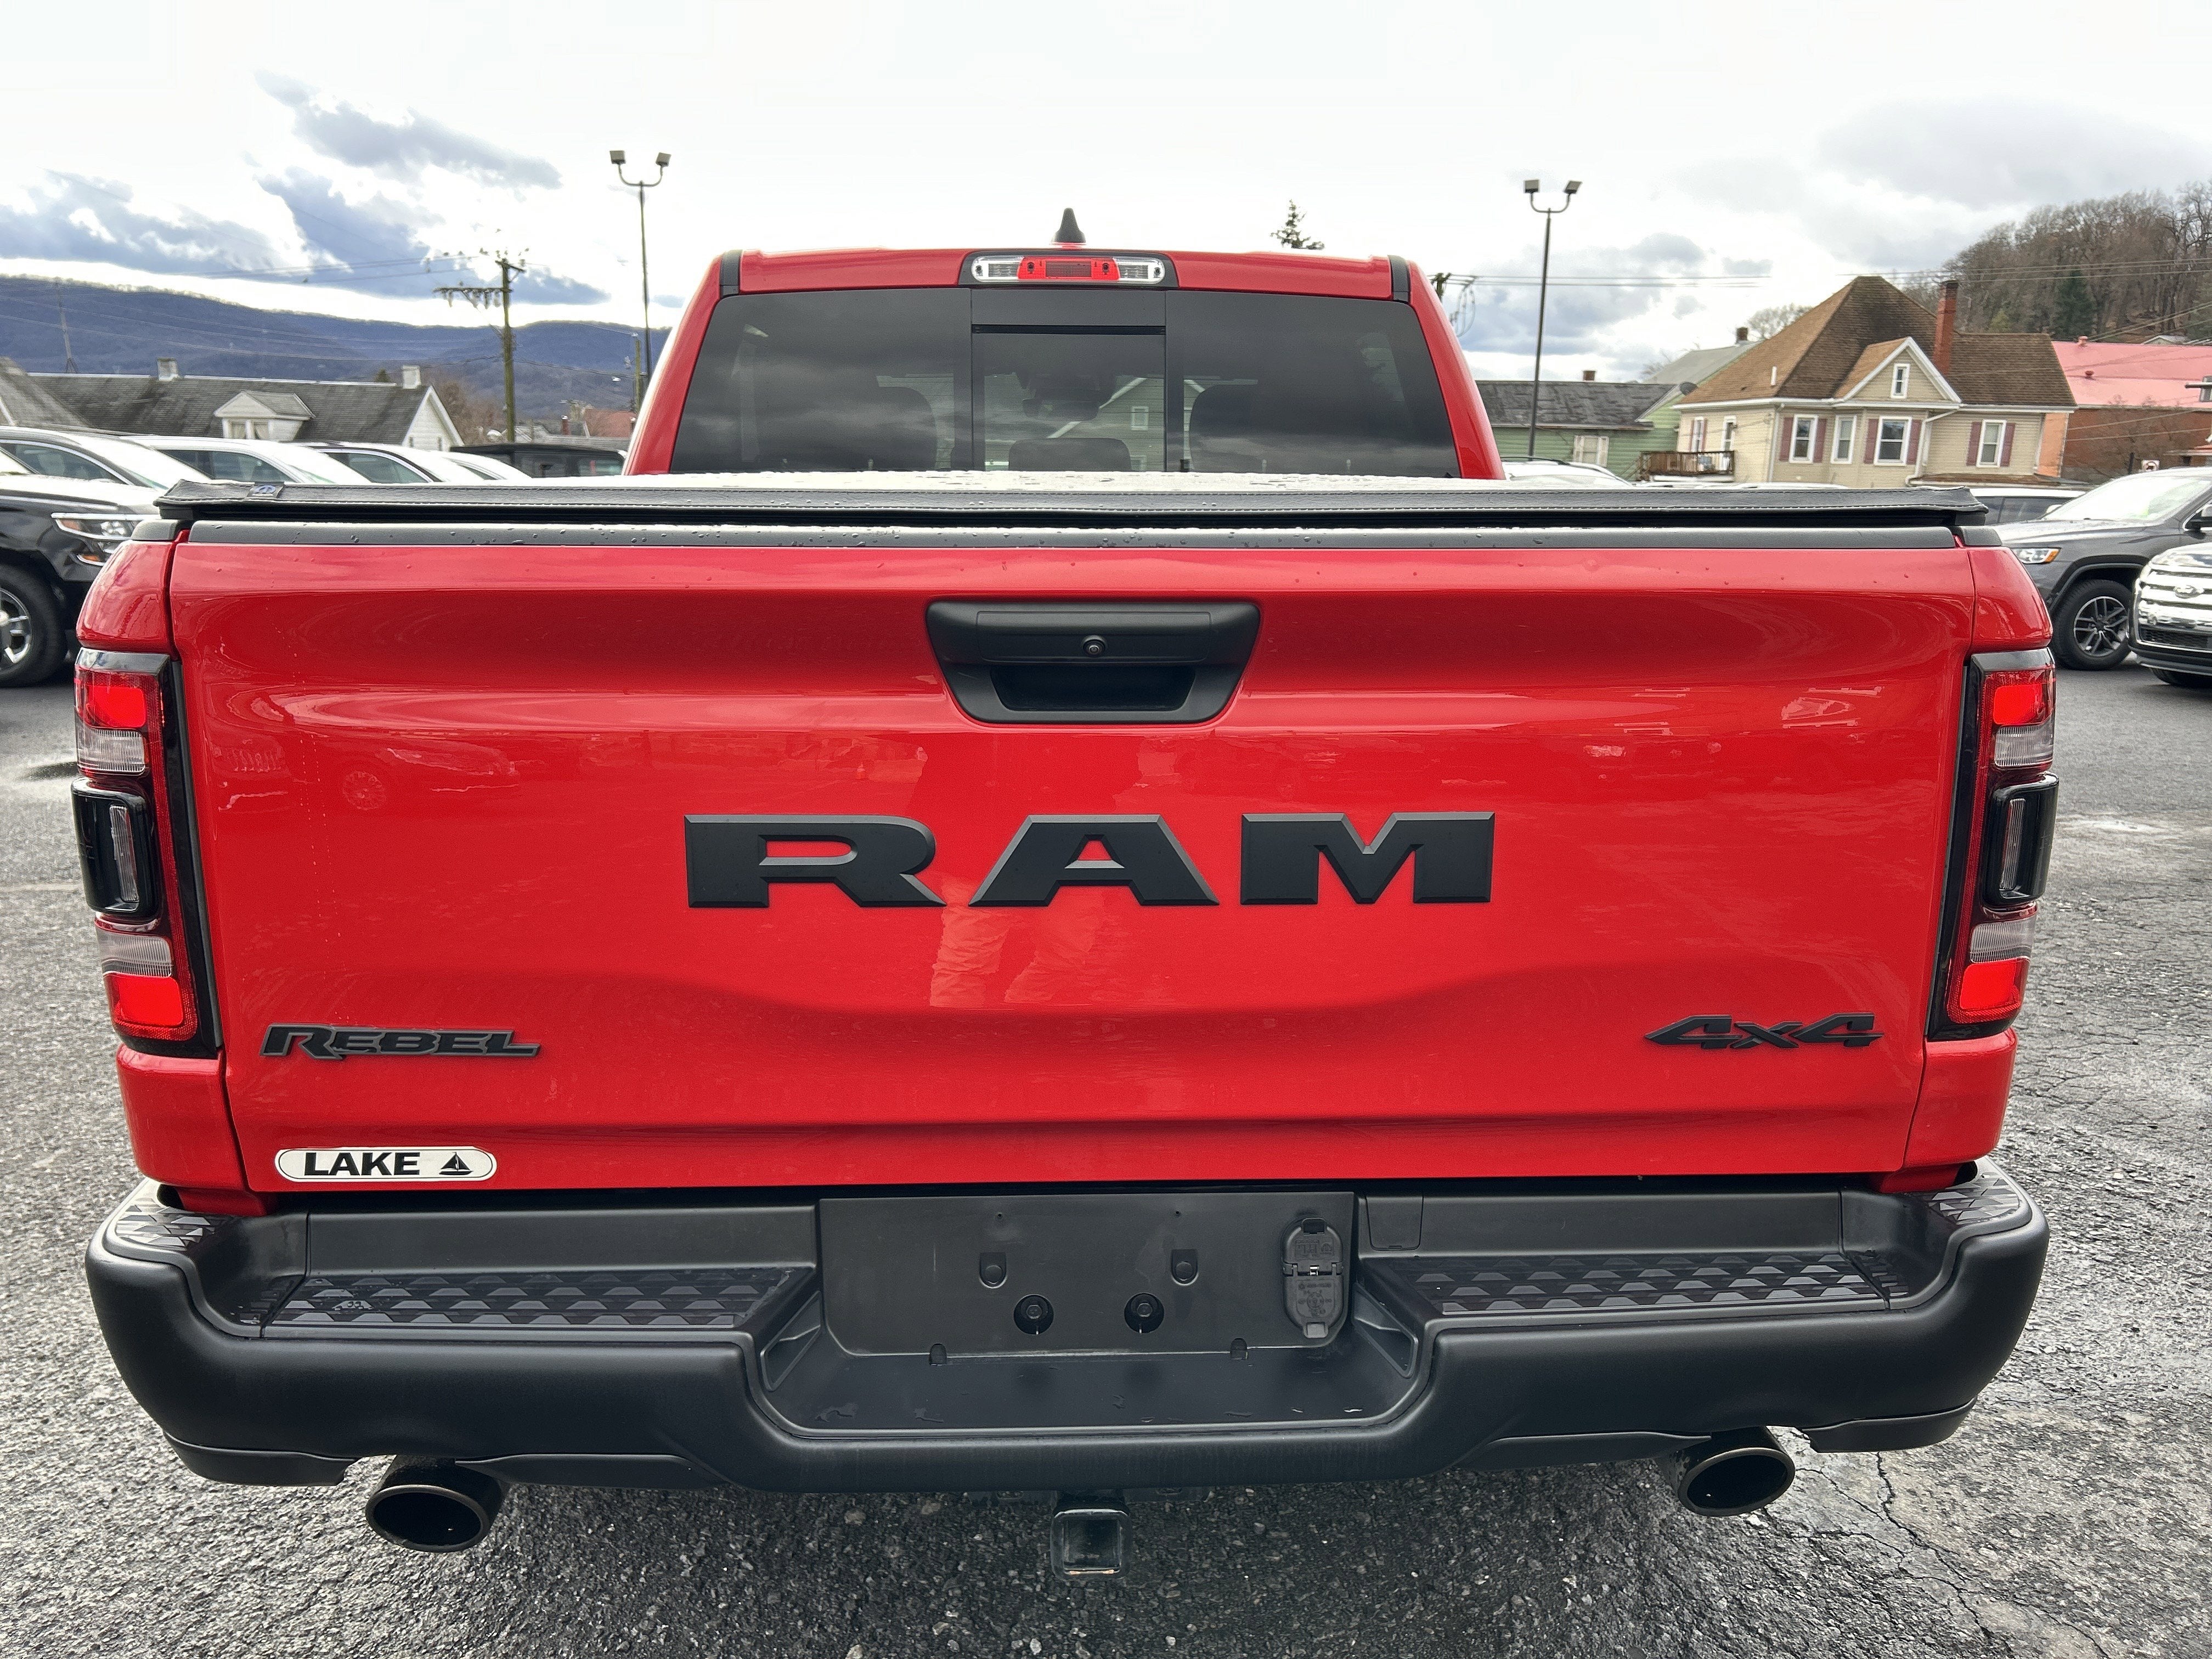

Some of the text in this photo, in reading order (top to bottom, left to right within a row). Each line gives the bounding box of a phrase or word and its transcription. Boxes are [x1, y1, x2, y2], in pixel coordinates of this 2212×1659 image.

[684, 812, 1496, 909] RAM
[259, 1023, 541, 1060] REBEL
[303, 1152, 420, 1176] LAKE
